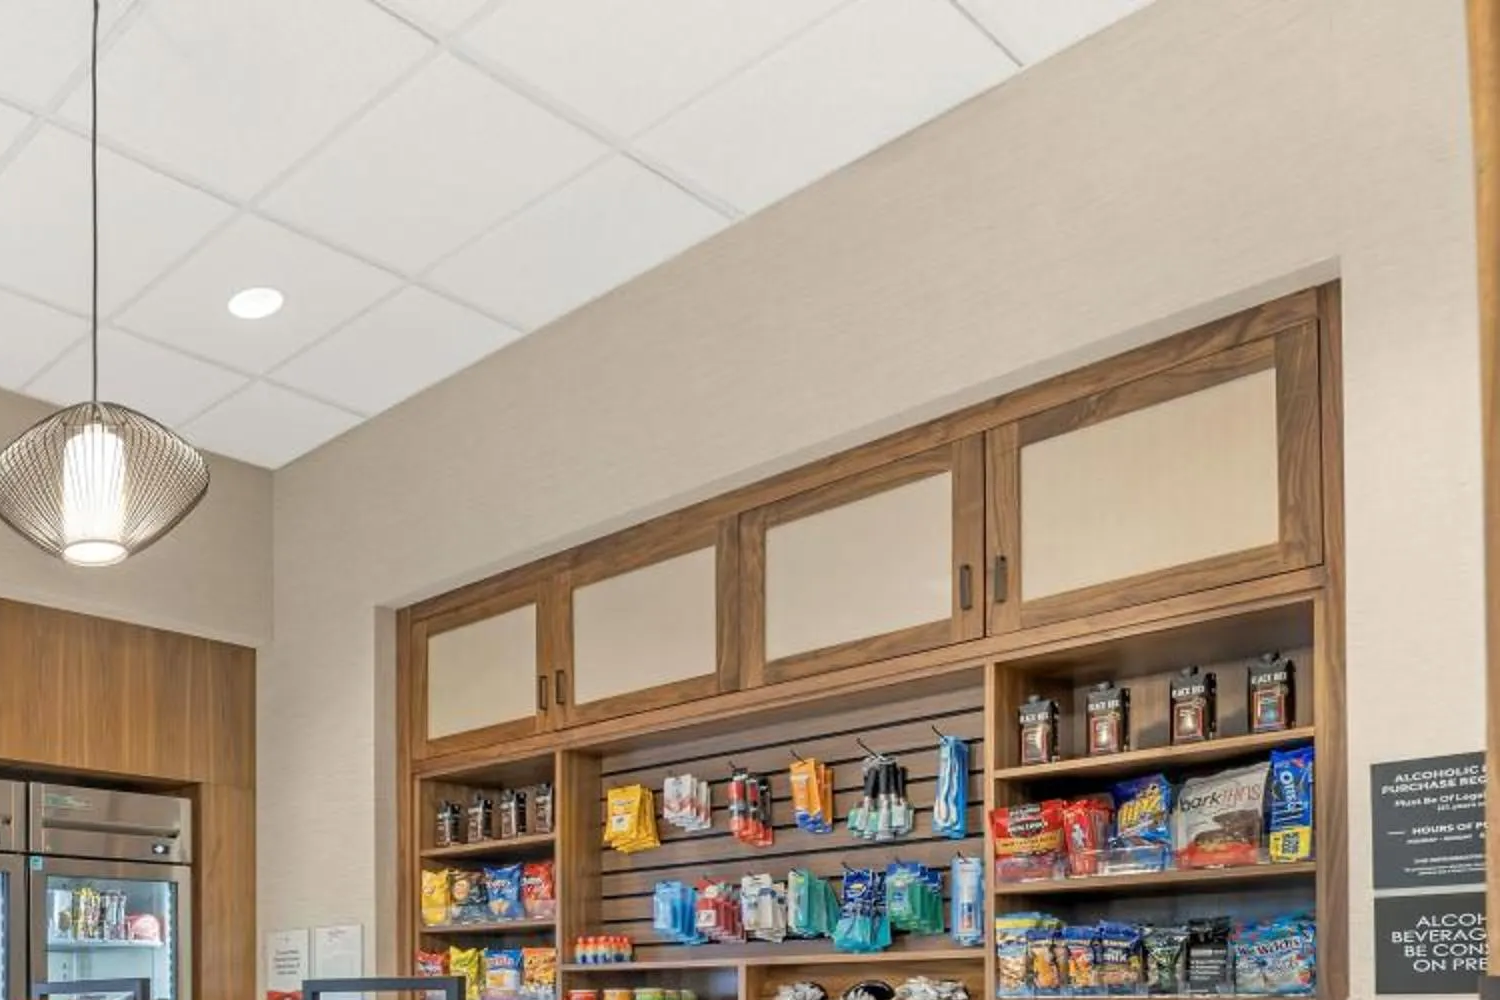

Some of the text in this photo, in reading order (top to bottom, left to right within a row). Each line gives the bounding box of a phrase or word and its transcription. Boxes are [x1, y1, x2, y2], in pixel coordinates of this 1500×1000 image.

[1395, 764, 1480, 783] ALCOHOLIC
[1381, 777, 1457, 795] PURCHASE
[1411, 823, 1455, 836] HOURS
[1390, 927, 1488, 944] BEVERAG
[1404, 944, 1428, 958] BE
[1412, 958, 1447, 973] ON
